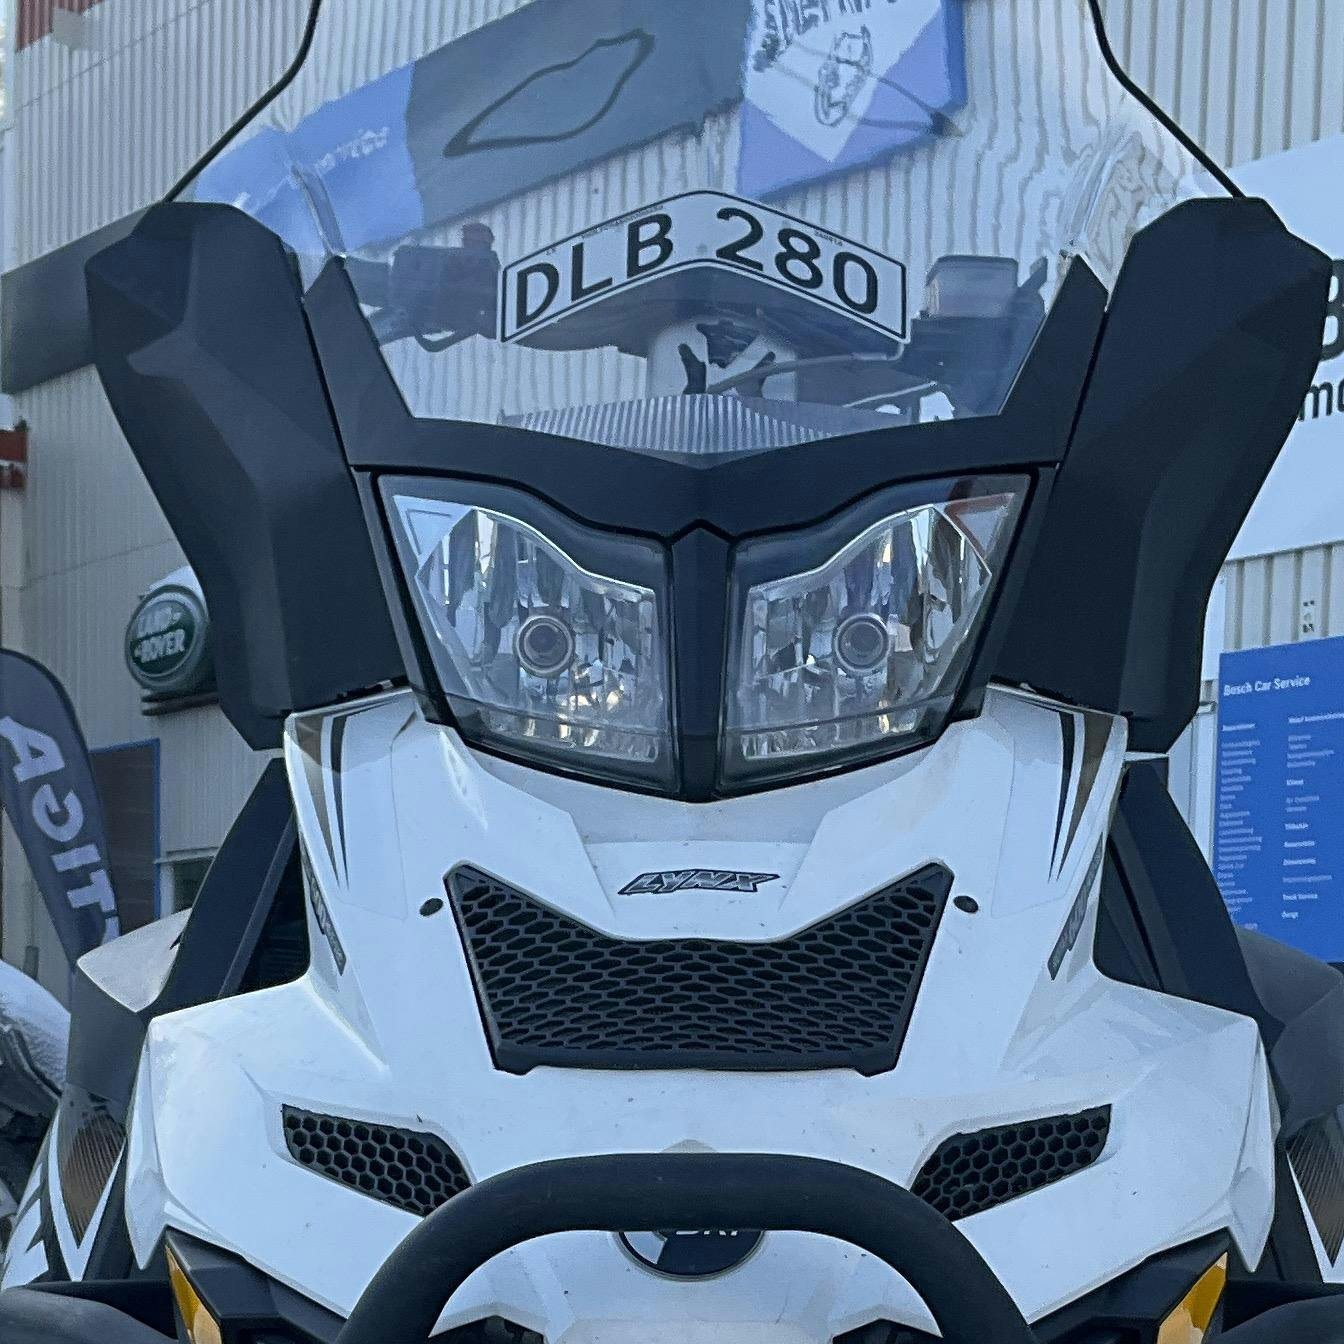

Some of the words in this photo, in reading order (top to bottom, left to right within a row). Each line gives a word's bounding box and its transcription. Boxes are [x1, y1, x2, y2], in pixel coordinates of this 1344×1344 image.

[516, 213, 674, 330] DLB
[716, 207, 878, 315] 280
[1274, 675, 1311, 690] Service
[619, 869, 780, 895] LYNX
